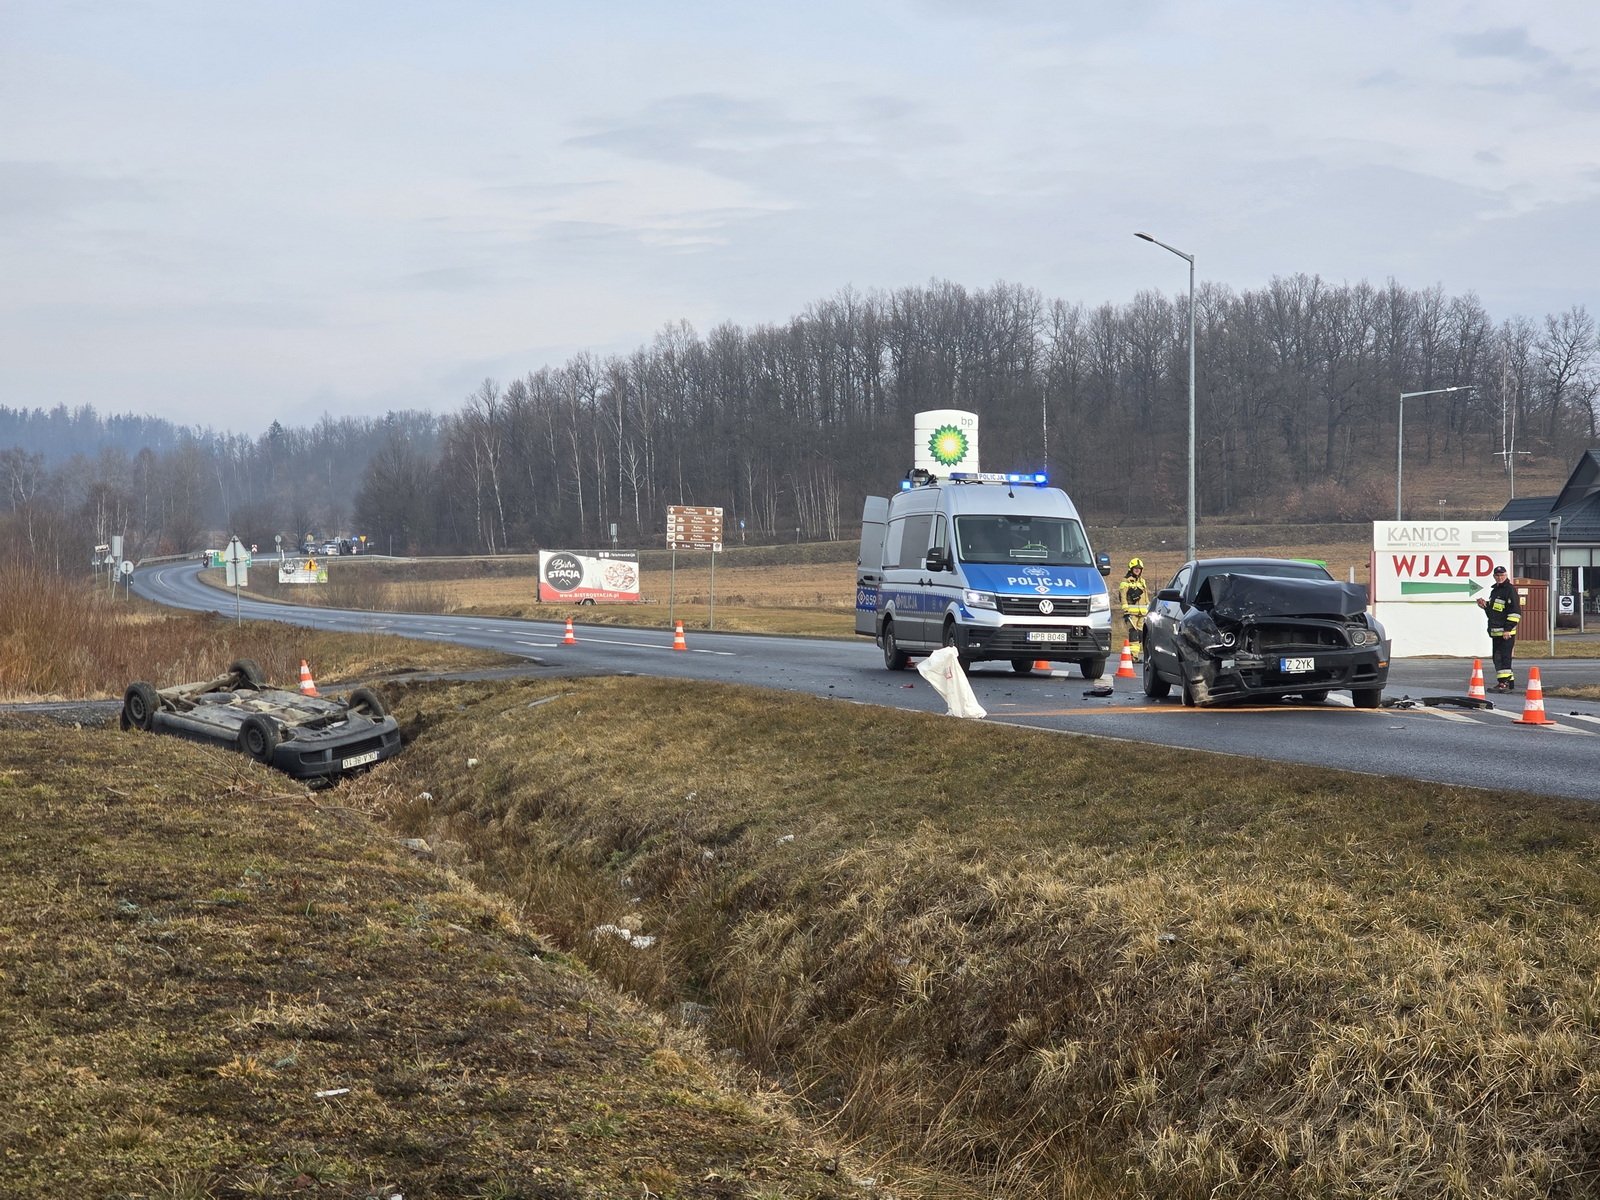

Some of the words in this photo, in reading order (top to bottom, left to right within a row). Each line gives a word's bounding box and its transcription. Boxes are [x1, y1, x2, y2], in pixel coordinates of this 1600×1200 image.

[960, 416, 974, 427] bp
[978, 473, 1005, 482] POLICJA
[1387, 527, 1460, 542] KANTOR
[551, 558, 576, 570] Bistro
[1392, 555, 1494, 577] WJAZD
[547, 569, 581, 579] STACJA
[1007, 577, 1077, 588] POLICJA
[900, 594, 918, 610] POLICJA
[1031, 633, 1045, 641] HPB
[1286, 660, 1293, 670] Z
[1295, 659, 1313, 670] 2YK
